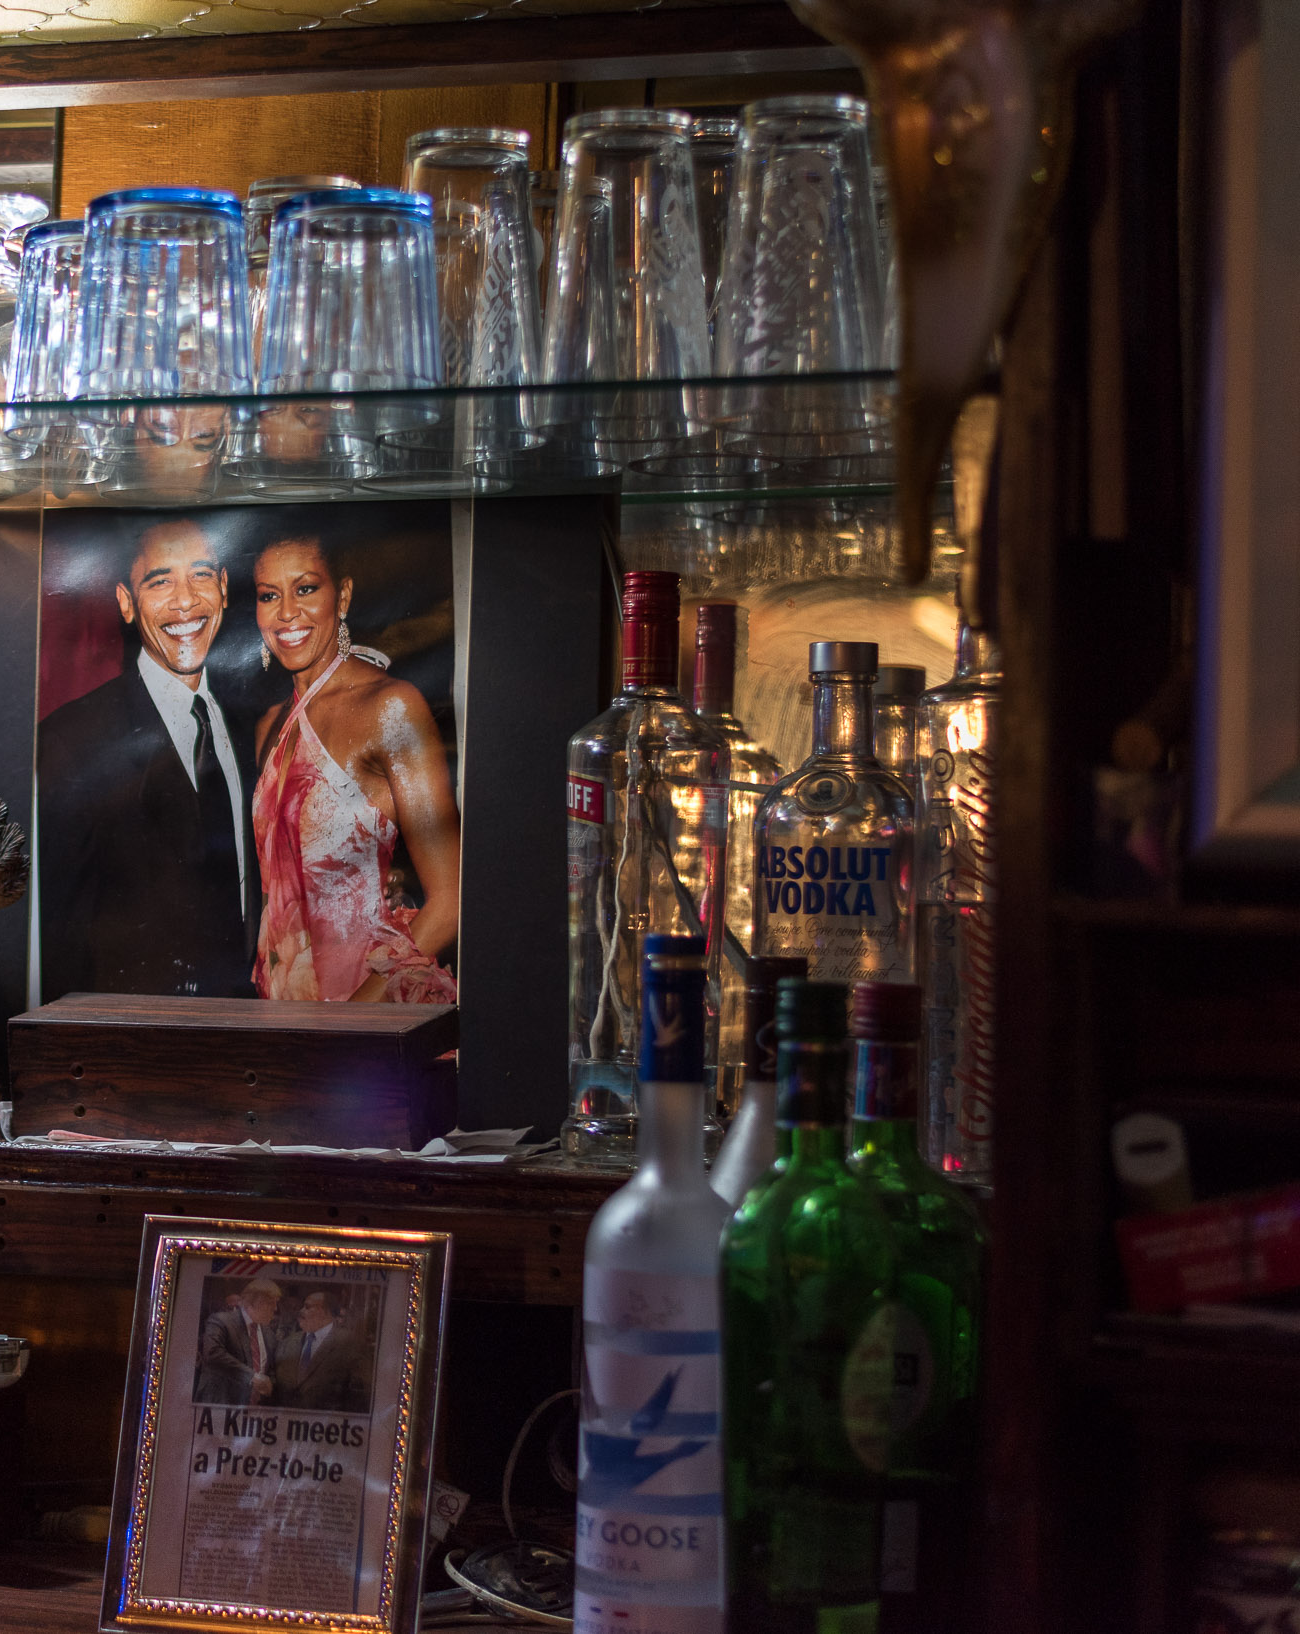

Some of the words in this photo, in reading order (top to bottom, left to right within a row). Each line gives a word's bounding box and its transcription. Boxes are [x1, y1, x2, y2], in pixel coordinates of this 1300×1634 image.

[758, 846, 892, 882] ABSOLUT
[766, 881, 877, 916] VODKA
[196, 1408, 214, 1435] A
[223, 1409, 278, 1446] King
[287, 1418, 364, 1448] meets
[194, 1453, 209, 1475] a
[216, 1447, 344, 1482] Prez-to-be
[601, 1520, 701, 1550] GOOSE
